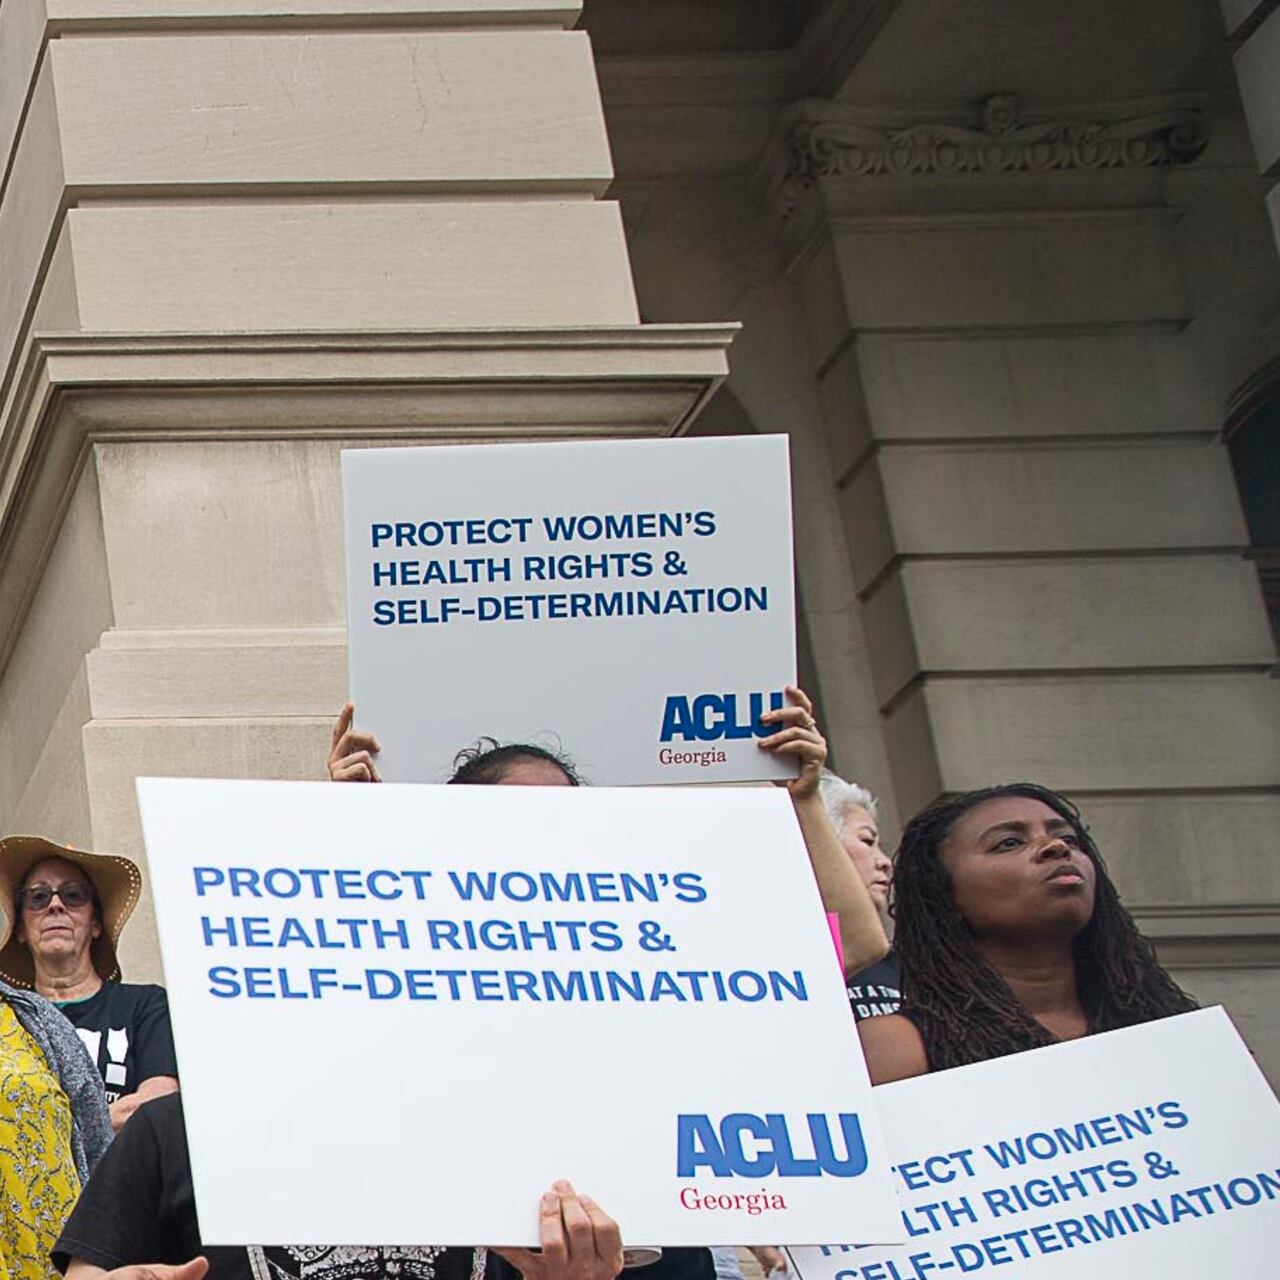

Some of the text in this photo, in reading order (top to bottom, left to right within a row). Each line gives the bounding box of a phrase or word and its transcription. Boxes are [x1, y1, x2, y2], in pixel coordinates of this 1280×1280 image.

[371, 511, 717, 548] PROTECT WOMEN'S
[372, 551, 688, 586] HEALTH RIGHTS &
[372, 587, 768, 625] SELF-DETERMINATION
[659, 692, 785, 742] ACLU
[659, 749, 727, 767] Georgia
[191, 867, 708, 903] PROTECT WOMEN'S
[200, 917, 677, 952] HEALTH RIGHTS &
[207, 966, 809, 1002] SELF-DETERMINATION
[675, 1113, 869, 1179] ACLU
[891, 1100, 1189, 1191] ECT WOMEN'S
[679, 1187, 788, 1216] Georgia
[982, 1158, 1139, 1219] RIGHTS
[1146, 1151, 1180, 1180] &
